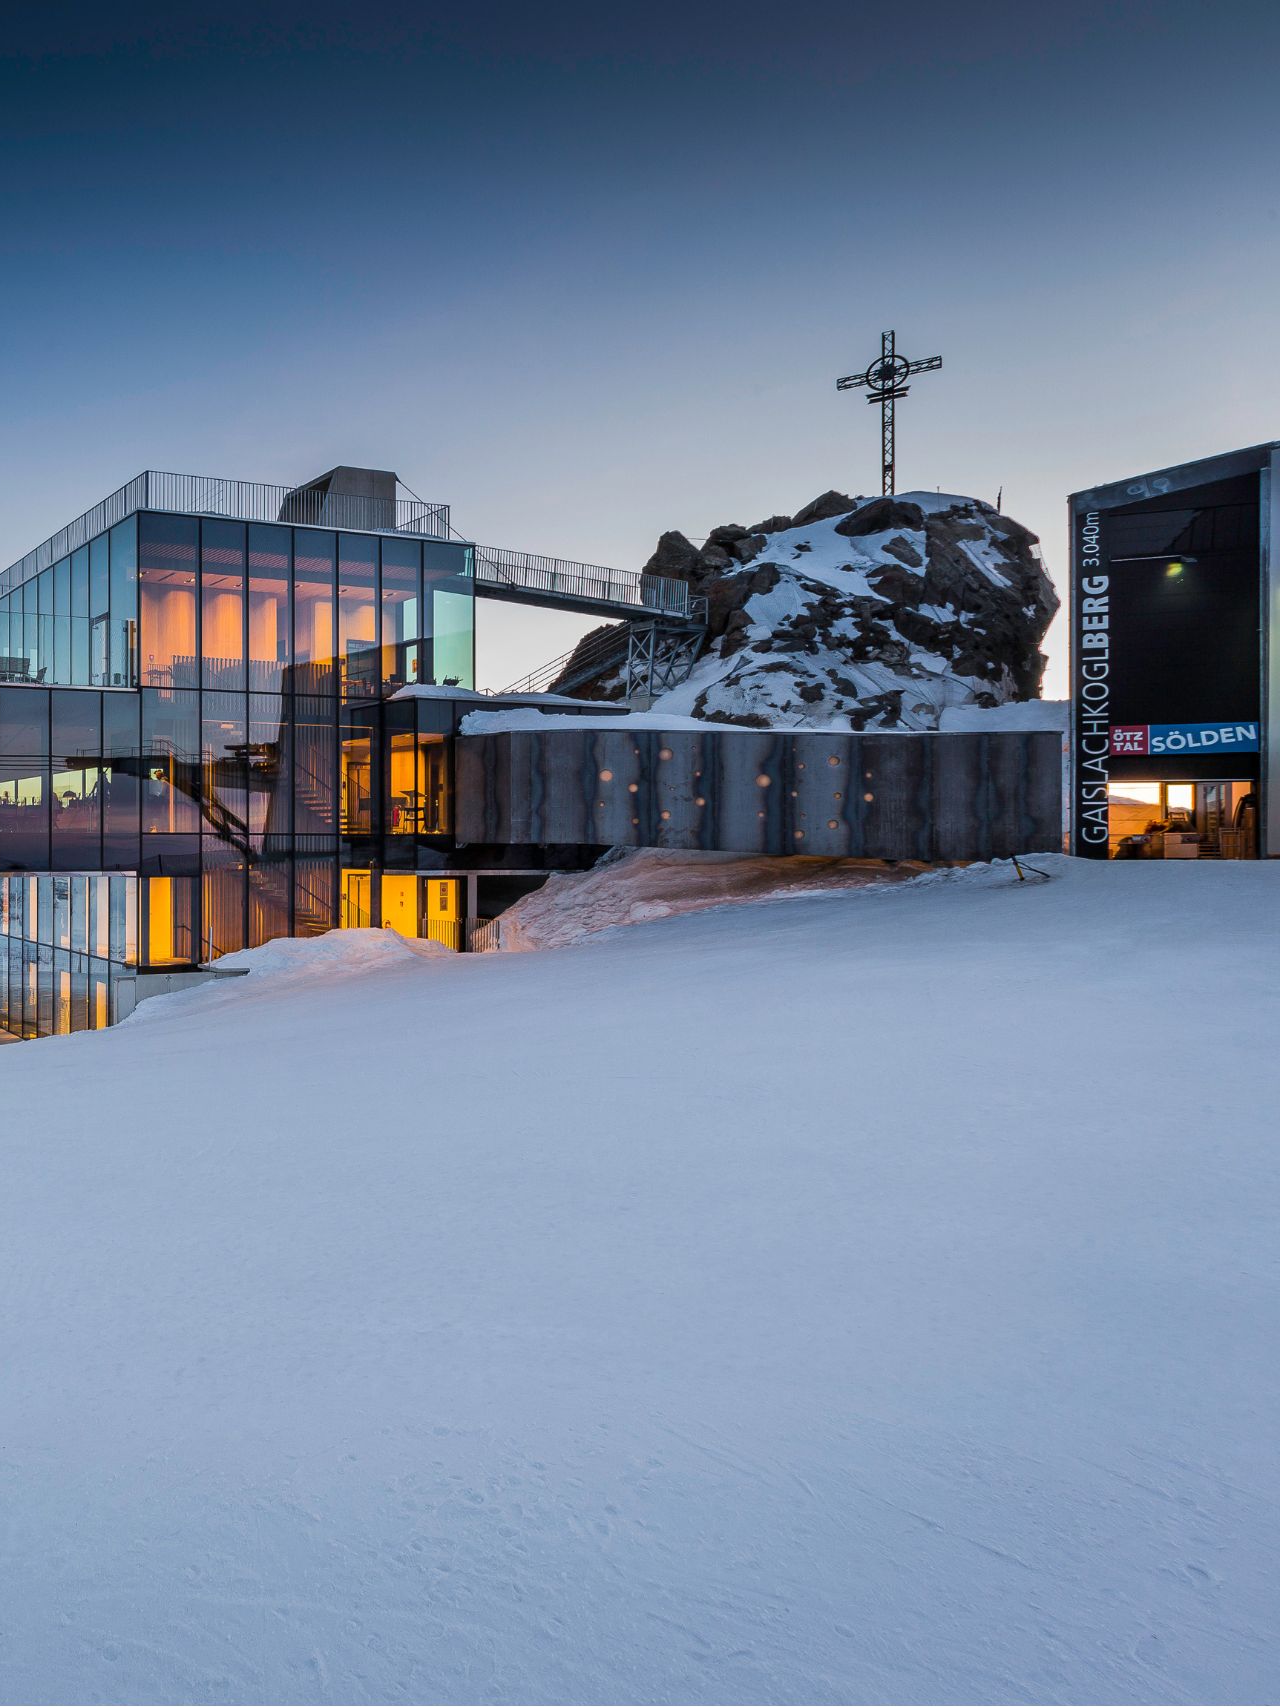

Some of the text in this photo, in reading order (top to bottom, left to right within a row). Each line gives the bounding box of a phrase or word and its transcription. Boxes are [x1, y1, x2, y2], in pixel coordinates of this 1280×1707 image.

[1082, 511, 1109, 843] GAISLACHKOGLBERG 3.040m
[1113, 729, 1143, 741] ÖTZ
[1151, 724, 1257, 752] SÖLDEN
[1113, 742, 1143, 751] TAL
